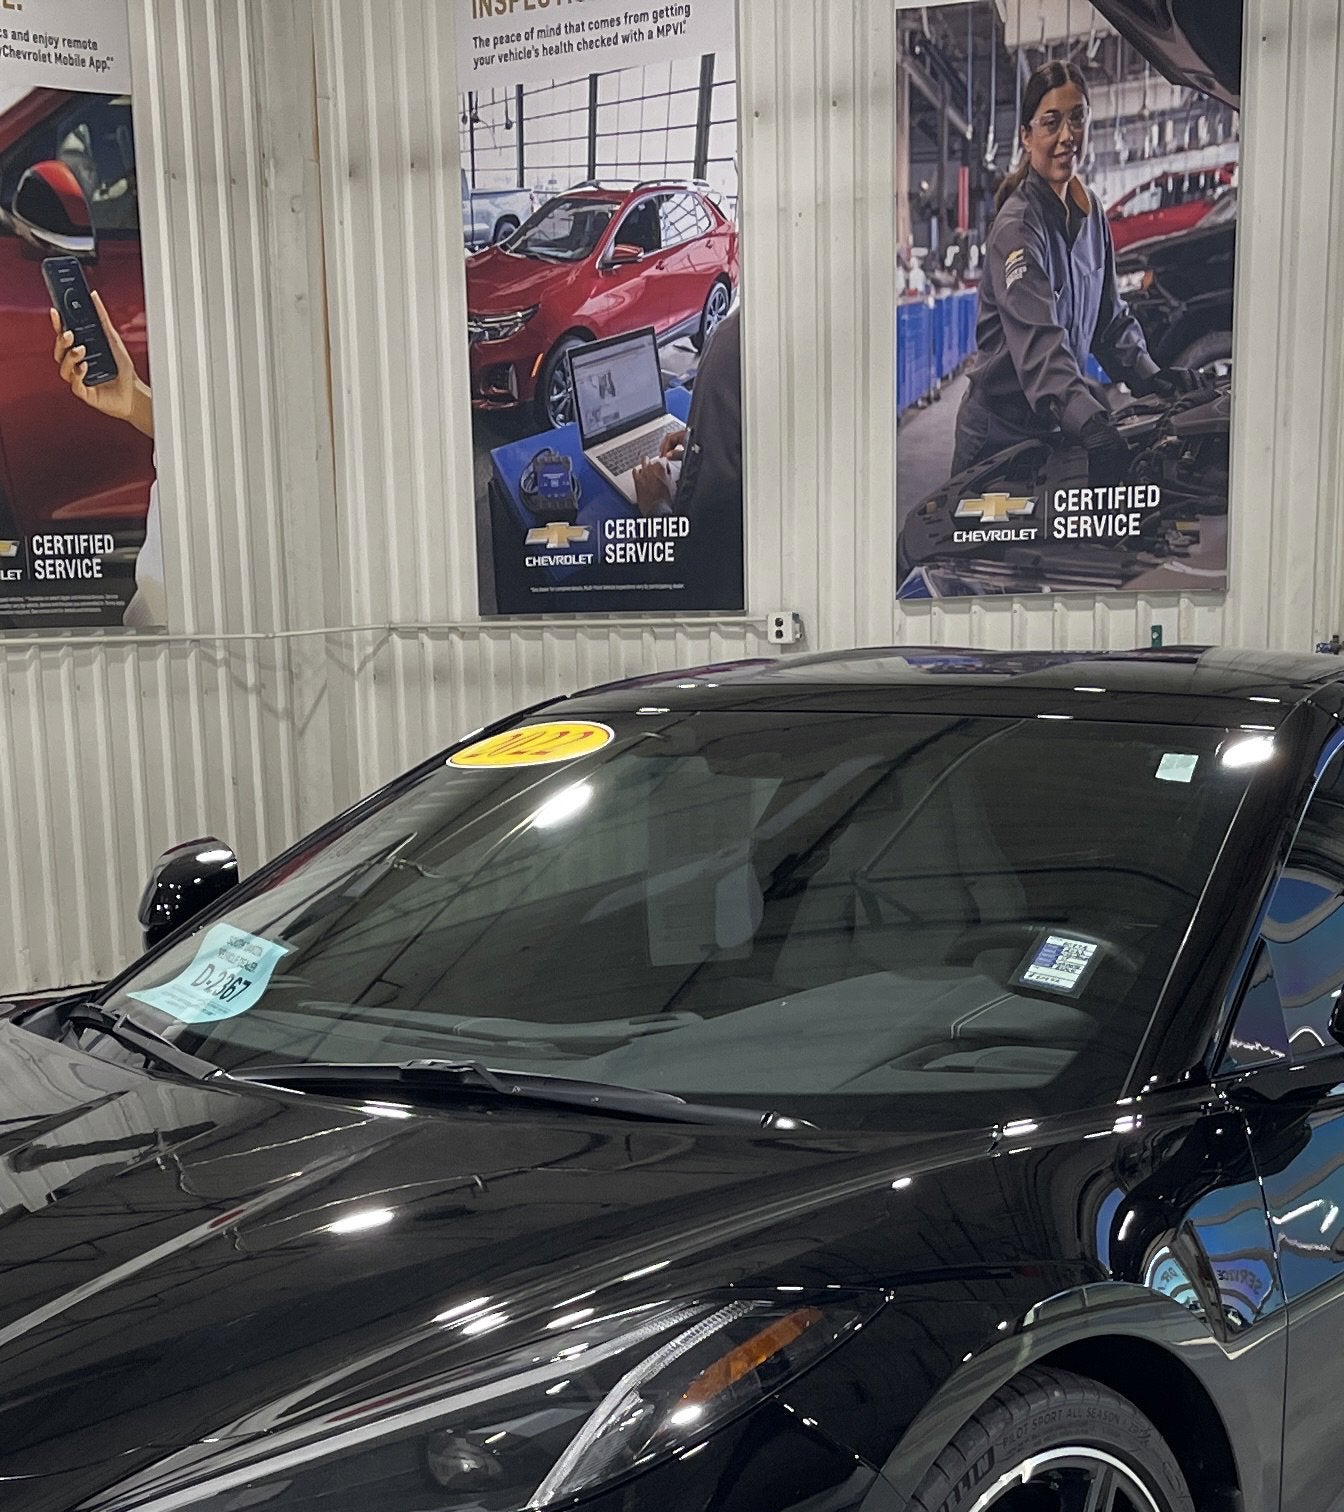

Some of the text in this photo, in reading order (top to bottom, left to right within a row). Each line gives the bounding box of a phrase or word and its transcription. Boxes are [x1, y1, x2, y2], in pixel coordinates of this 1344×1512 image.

[473, 3, 691, 49] The peace of mind that comes from getting
[11, 29, 30, 42] and
[32, 32, 59, 49] enjoy
[62, 37, 98, 51] remote
[473, 54, 496, 70] your
[498, 45, 540, 63] vehicle's
[542, 40, 574, 56] health
[576, 32, 619, 51] checked
[621, 28, 645, 43] with
[647, 29, 654, 40] a
[54, 51, 86, 67] Mobile
[1053, 484, 1161, 512] CERTIFIED
[605, 516, 690, 540] CERTIFIED
[953, 528, 1038, 543] CHEVROLET
[1053, 513, 1141, 539] SERVICE
[32, 534, 115, 556] CERTIFIED
[605, 541, 675, 564] SERVICE
[34, 558, 103, 580] SERVICE
[525, 553, 594, 567] CHEVROLET
[1031, 1409, 1063, 1431] SPORT
